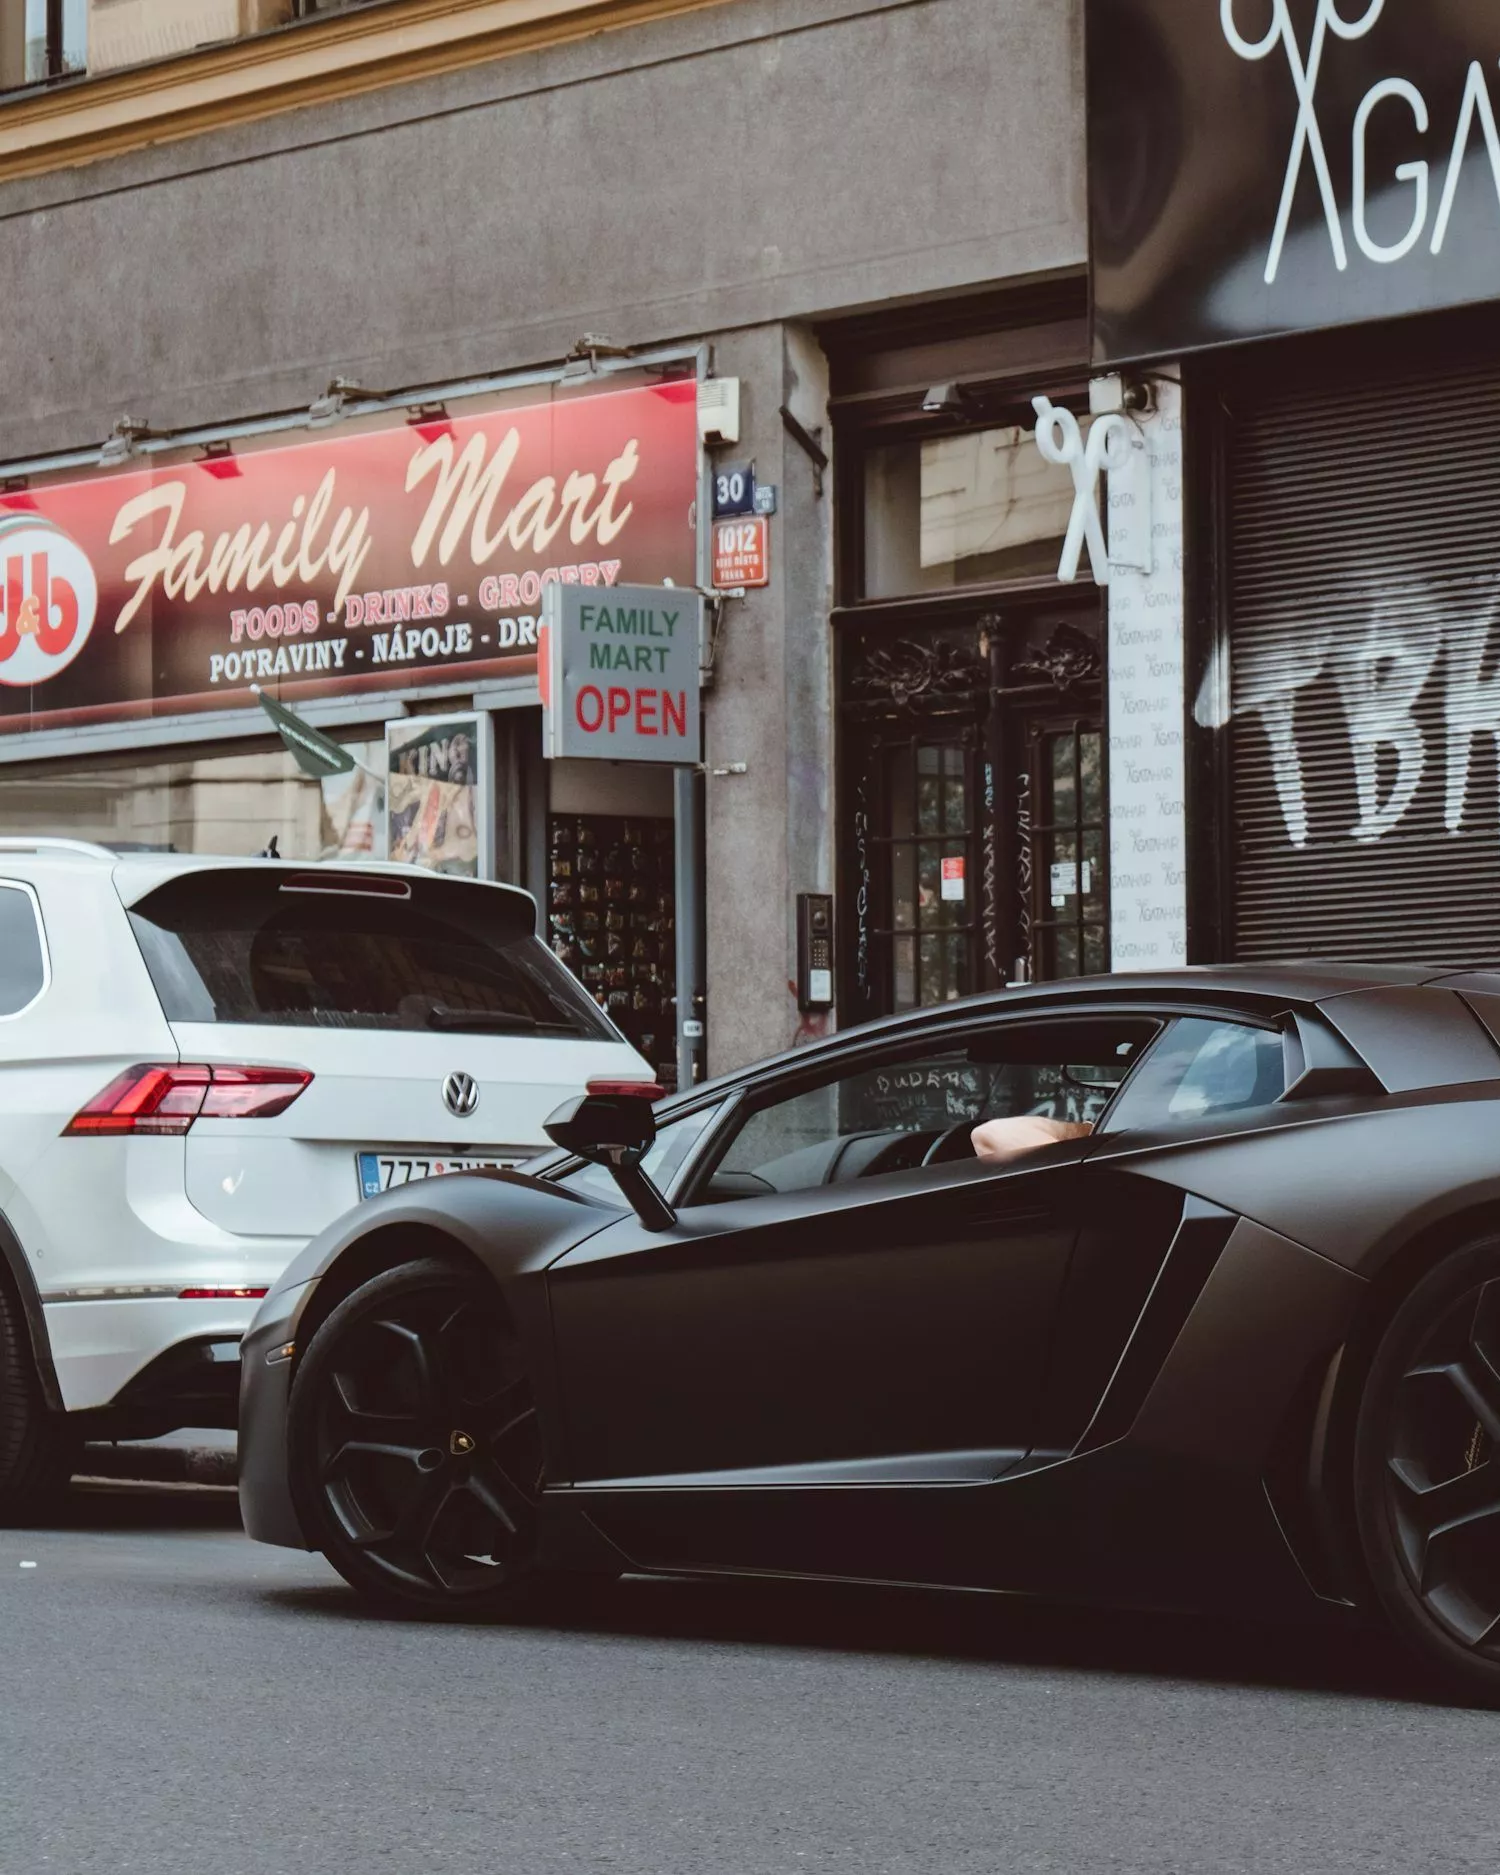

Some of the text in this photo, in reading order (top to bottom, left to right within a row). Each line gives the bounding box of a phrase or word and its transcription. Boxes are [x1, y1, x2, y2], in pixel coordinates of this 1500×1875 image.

[716, 472, 744, 504] 30
[109, 426, 642, 634] Family Mart
[717, 523, 757, 554] 1012
[230, 599, 320, 644] FOODS
[344, 582, 450, 628] DRINKS
[579, 604, 680, 637] FAMILY
[209, 638, 348, 684] POTRAVINY
[372, 622, 473, 664] NÁPOJE
[589, 642, 671, 673] MART
[575, 684, 687, 737] OPEN
[365, 1182, 379, 1193] CZ
